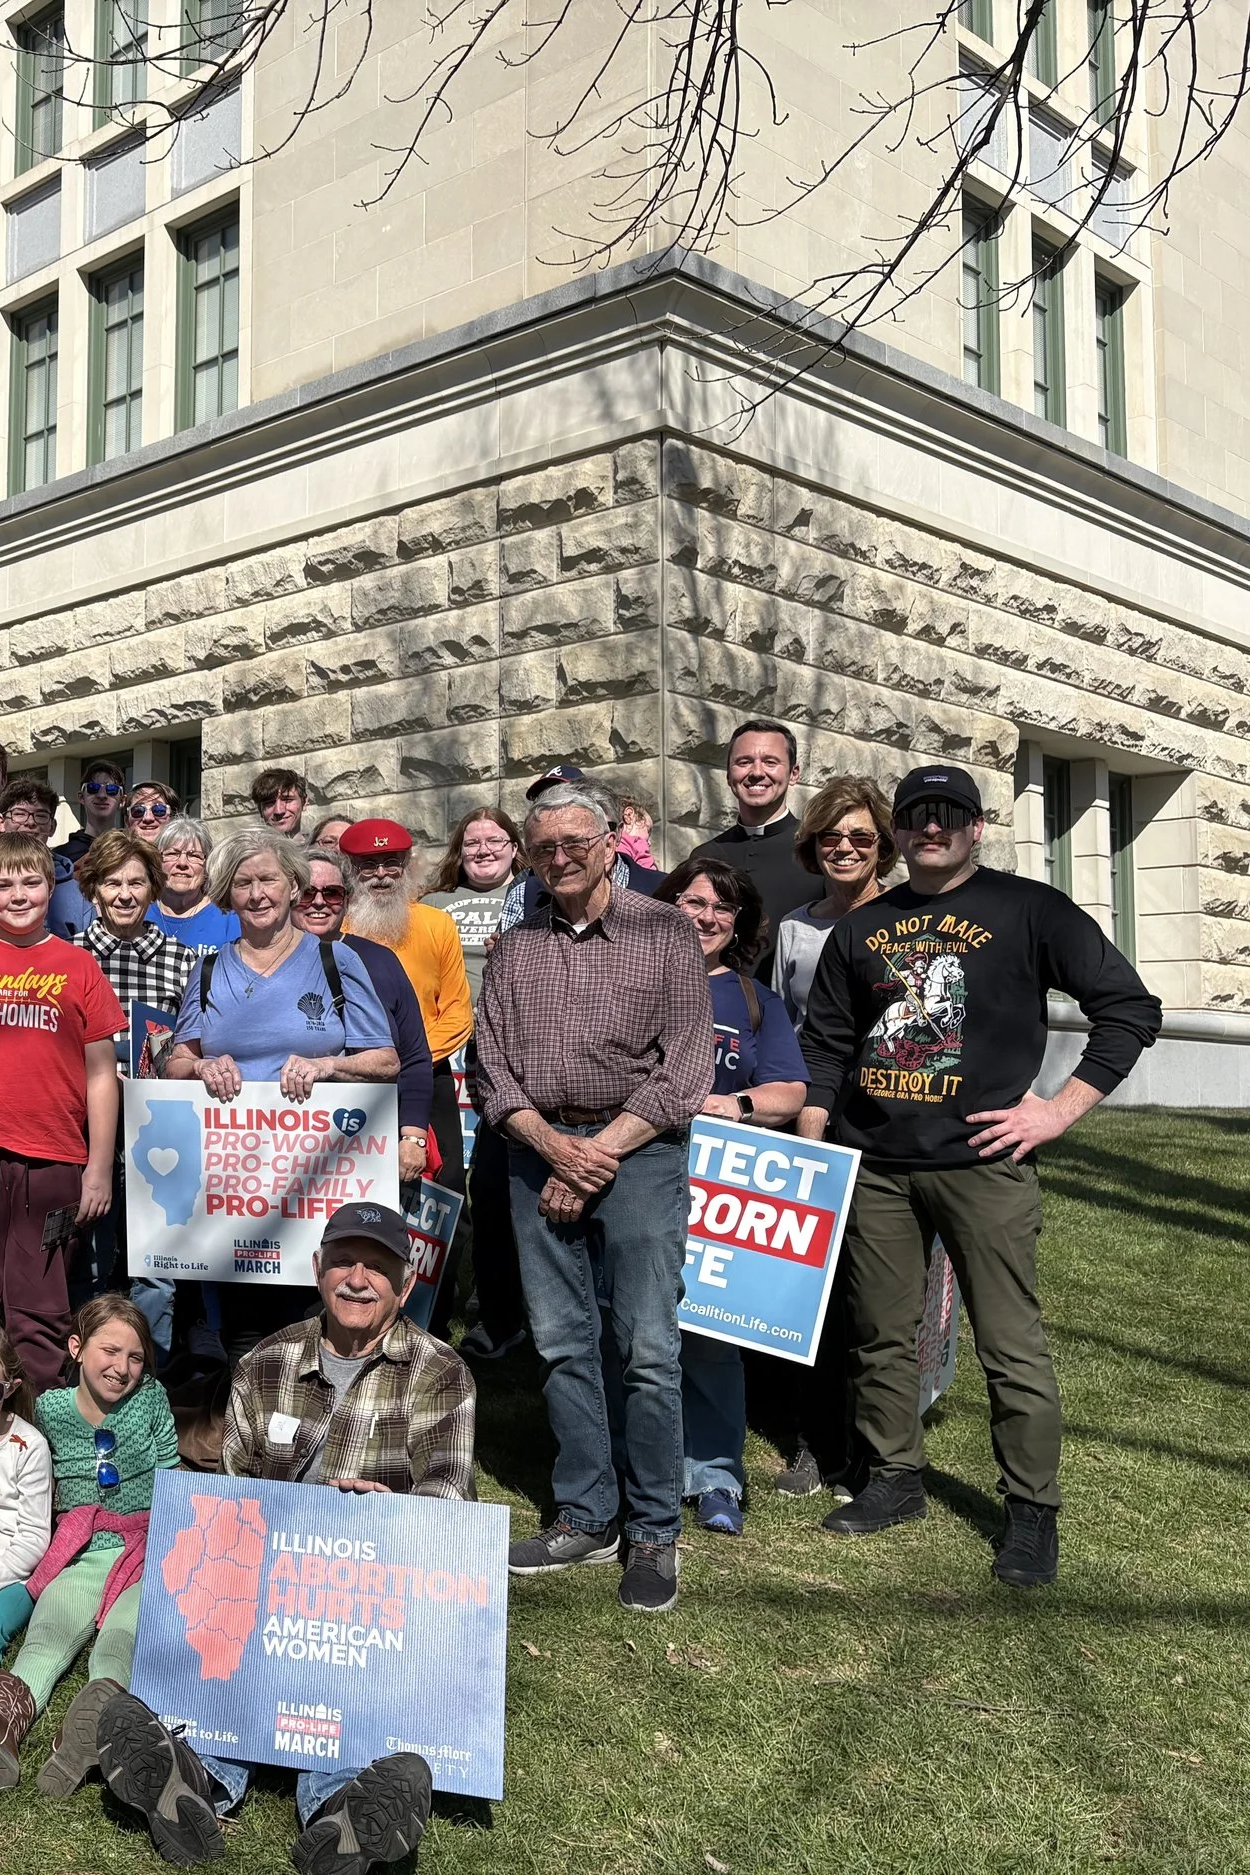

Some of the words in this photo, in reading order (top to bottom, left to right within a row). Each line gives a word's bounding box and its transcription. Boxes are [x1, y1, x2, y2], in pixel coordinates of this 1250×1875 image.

[451, 911, 502, 925] PAL
[865, 928, 890, 952] DO
[895, 915, 933, 936] NOT
[936, 914, 993, 949] MAKE
[880, 942, 910, 954] PEACE
[915, 941, 943, 953] WITH
[946, 941, 969, 953] EVIL
[860, 1067, 934, 1094] DESTROY
[942, 1075, 963, 1096] IT
[910, 1093, 923, 1101] PRO
[204, 1107, 331, 1132] ILLINOIS
[340, 1113, 360, 1132] is
[204, 1131, 387, 1155] PRO-WOMAN
[204, 1153, 356, 1176] PRO-CHILD
[692, 1133, 829, 1201] TECT
[205, 1174, 375, 1199] PRO-FAMILY
[206, 1194, 344, 1220] PRO-LIFE
[153, 1261, 178, 1270] Right
[180, 1262, 190, 1270] to
[191, 1262, 209, 1271] Life
[234, 1259, 281, 1274] MARCH
[680, 1298, 803, 1343] CoalitionLife.com
[272, 1532, 377, 1561] ILLINOIS
[268, 1552, 490, 1607] ABORTION
[266, 1583, 406, 1630] HURTS
[263, 1615, 404, 1651] AMERICAN
[262, 1635, 367, 1668] WOMEN
[164, 1714, 197, 1727] Illinois
[279, 1717, 338, 1735] PRO-LIFE
[200, 1729, 213, 1740] to
[214, 1730, 239, 1744] Life
[275, 1730, 340, 1759] MARCH
[385, 1736, 436, 1756] Thomas
[436, 1744, 472, 1762] More
